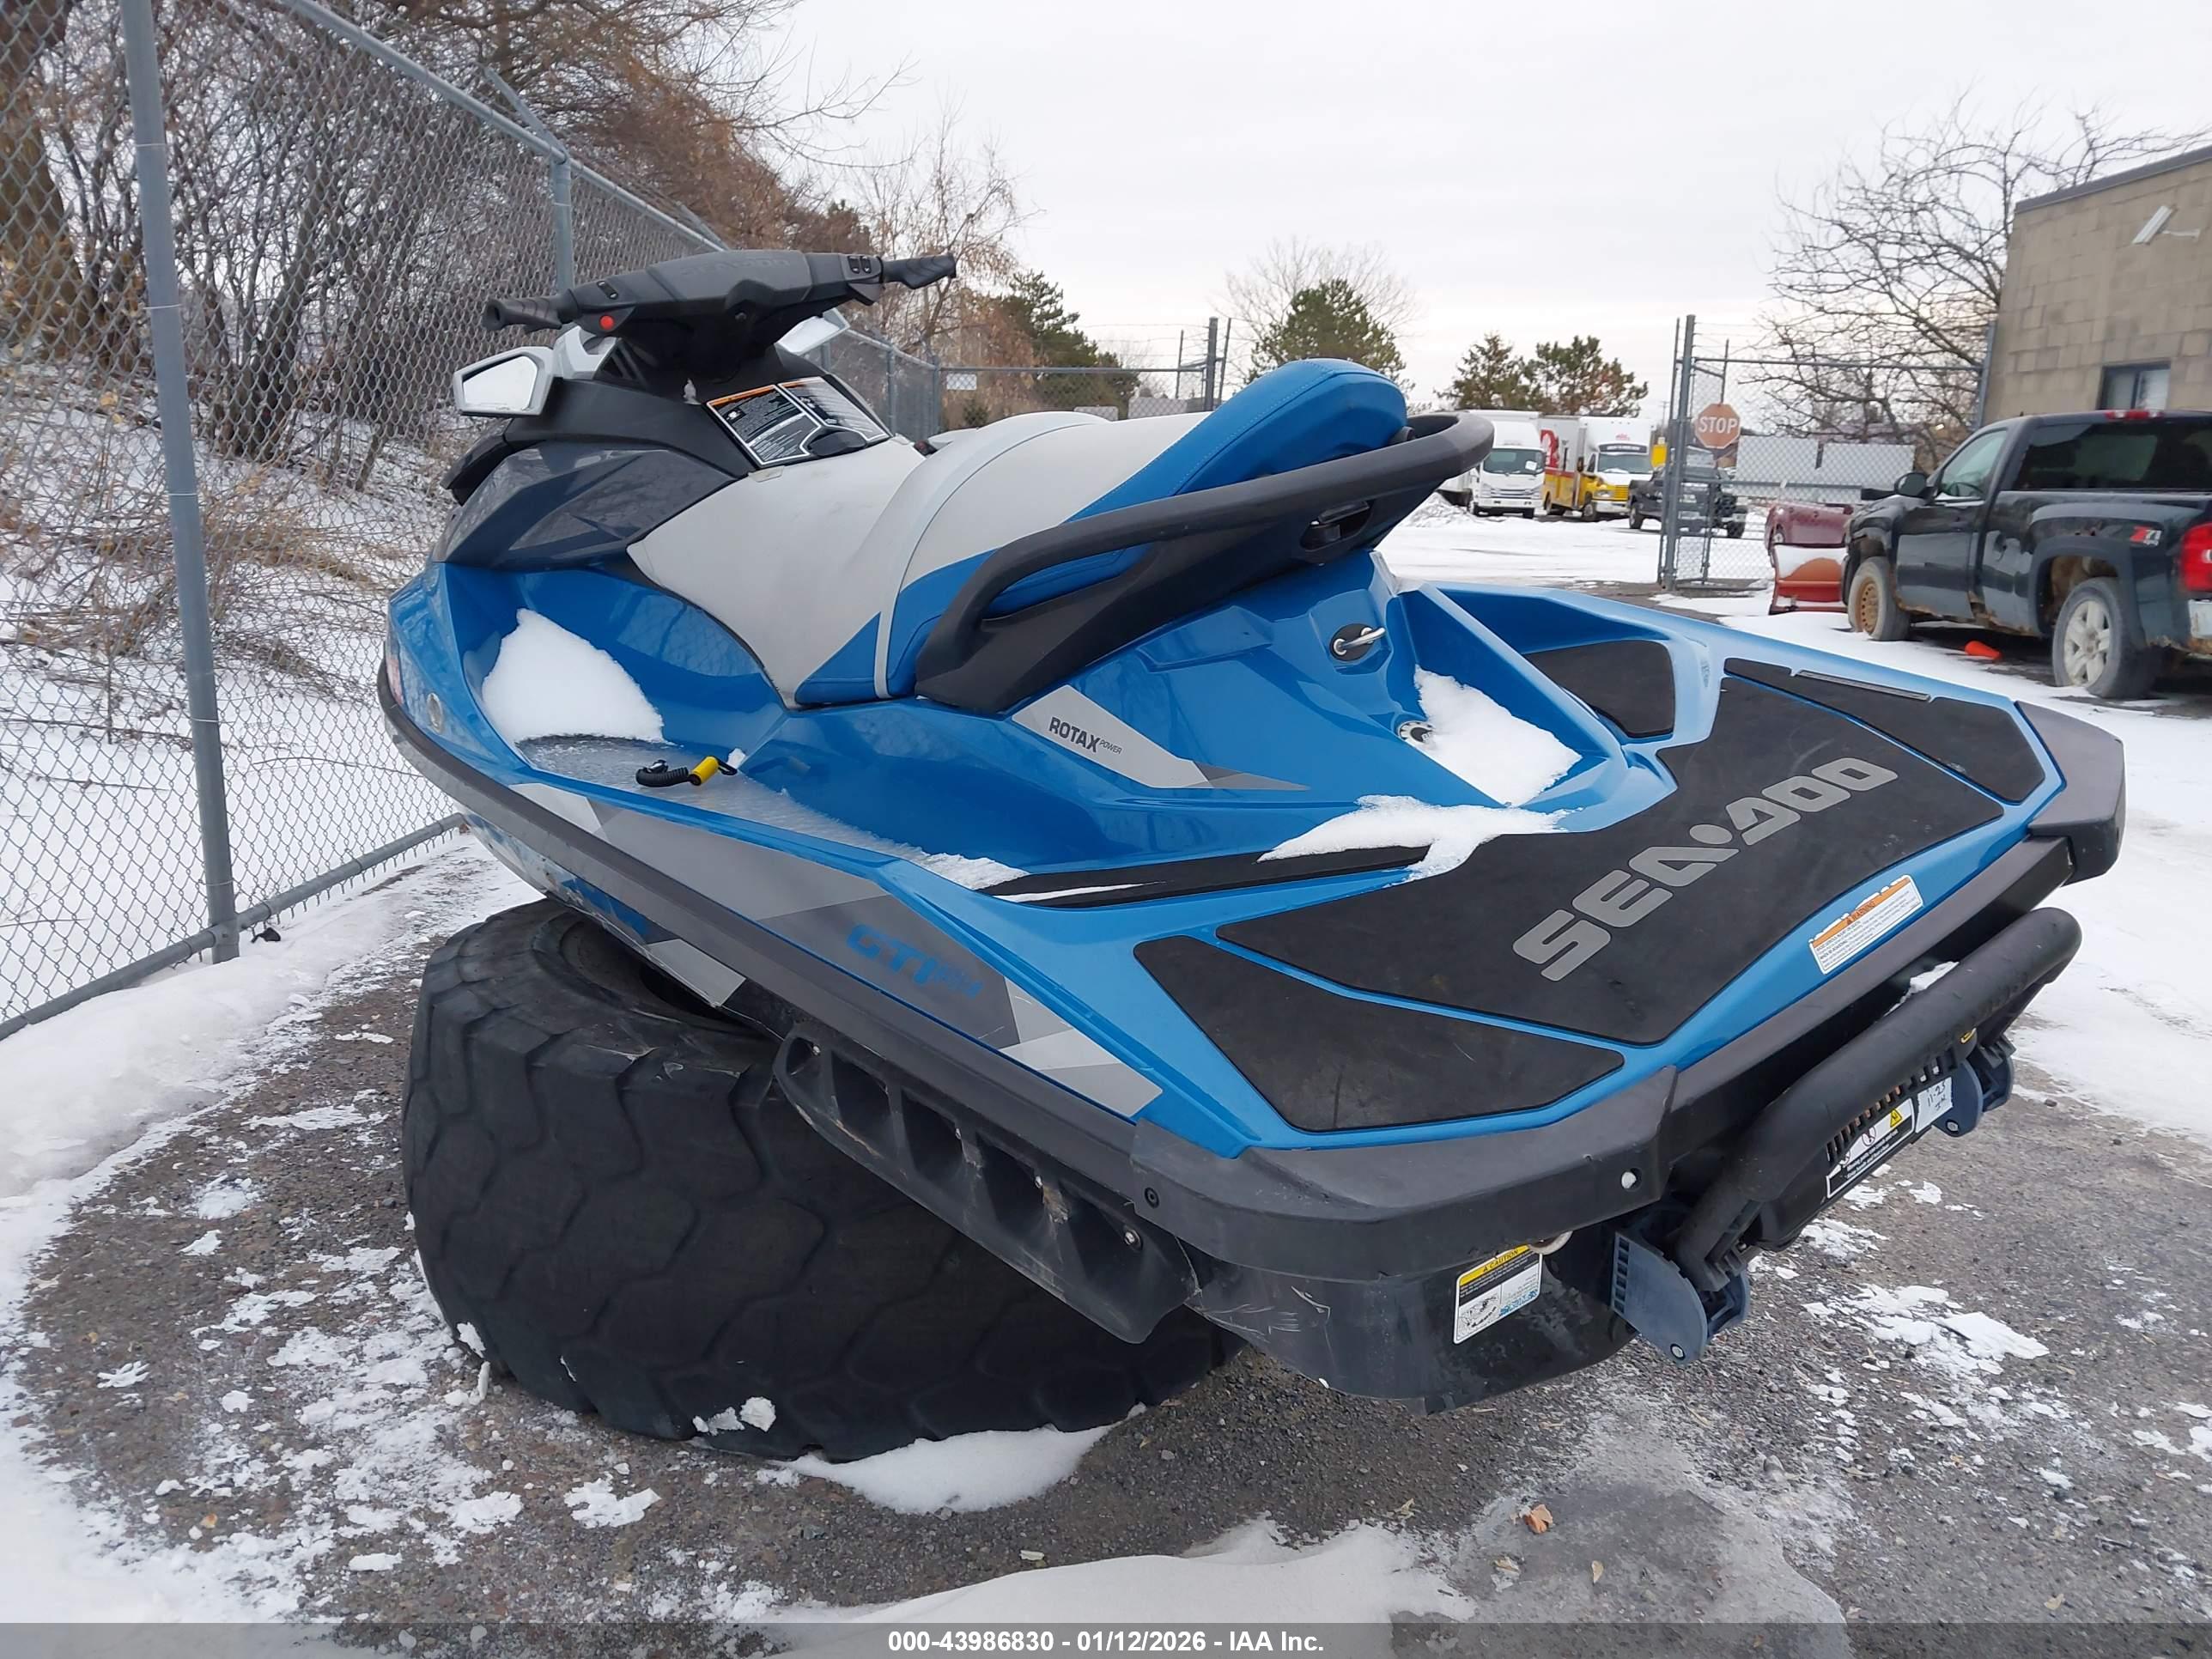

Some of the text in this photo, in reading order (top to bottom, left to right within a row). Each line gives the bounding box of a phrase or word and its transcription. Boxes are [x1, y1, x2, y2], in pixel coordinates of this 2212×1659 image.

[1698, 416, 1738, 434] STOP
[1048, 716, 1123, 755] ROTAX POWER
[1490, 1249, 1518, 1267] CAUTION
